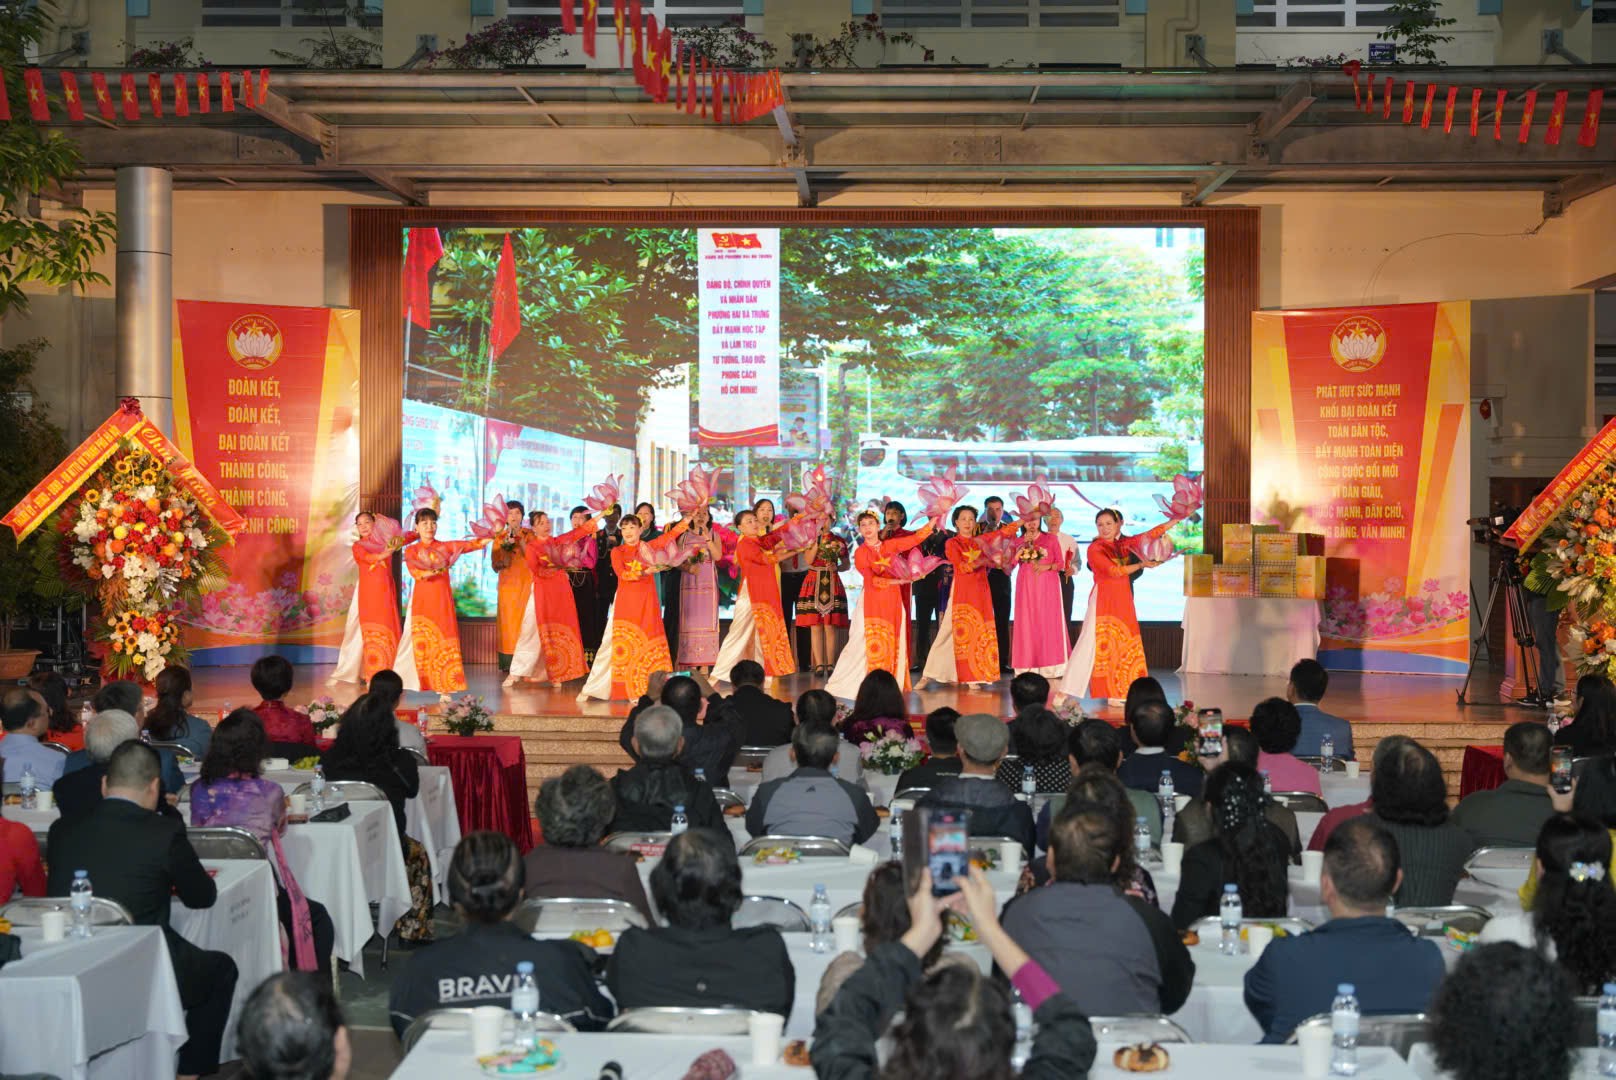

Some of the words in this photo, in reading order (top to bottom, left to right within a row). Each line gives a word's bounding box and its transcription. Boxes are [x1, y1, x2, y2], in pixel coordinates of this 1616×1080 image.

[734, 278, 750, 288] CHÍNH
[720, 294, 727, 303] VÀ
[729, 294, 744, 303] NHÂN
[746, 294, 757, 303] DÂN
[708, 310, 730, 319] PHƯỜNG
[732, 310, 740, 318] HAI
[752, 310, 769, 318] TRƯNG
[730, 339, 741, 348] LÀM
[743, 340, 756, 348] THEO
[722, 371, 740, 379] PHONG
[742, 370, 756, 379] CÁCH
[228, 376, 257, 395] ĐOÀN
[260, 376, 280, 398] KẾT,
[721, 383, 728, 394] HỒ
[730, 384, 738, 394] CHÍ
[1317, 384, 1337, 398] PHÁT
[1339, 385, 1355, 397] HUY
[1357, 382, 1373, 396] SỨC
[1376, 384, 1400, 399] MẠNH
[228, 403, 257, 423] ĐOÀN
[260, 403, 280, 424] KẾT,
[1320, 402, 1338, 418] KHỐI
[1341, 405, 1354, 420] ĐẠI
[1357, 402, 1378, 417] ĐOÀN
[1382, 400, 1397, 416] KẾT
[1328, 423, 1349, 437] TOÀN
[1351, 423, 1368, 437] DÂN
[1371, 422, 1388, 440] TỘC,
[219, 433, 236, 454] ĐẠI
[240, 432, 268, 451] ĐOÀN
[272, 430, 290, 451] KẾT
[1316, 441, 1331, 458] ĐẨY
[1334, 446, 1358, 462] MẠNH
[1360, 443, 1381, 457] TOÀN
[1384, 442, 1403, 460] DIỆN
[220, 459, 254, 478] THÀNH
[258, 460, 288, 479] CÔNG,
[1318, 462, 1339, 478] CÔNG
[1342, 463, 1364, 481] CUỘC
[1366, 461, 1380, 477] ĐỔI
[1382, 463, 1398, 477] MỚI
[220, 487, 254, 506] THÀNH
[257, 487, 288, 507] CÔNG,
[1343, 483, 1359, 498] DÂN
[1361, 483, 1383, 499] GIÀU,
[1336, 506, 1363, 520] MẠNH,
[1365, 504, 1382, 518] DÂN
[1385, 502, 1404, 519] CHỦ,
[267, 515, 299, 534] CÔNG!
[1334, 522, 1358, 538] BẰNG,
[1361, 523, 1380, 538] VĂN
[1381, 525, 1405, 538] MINH!
